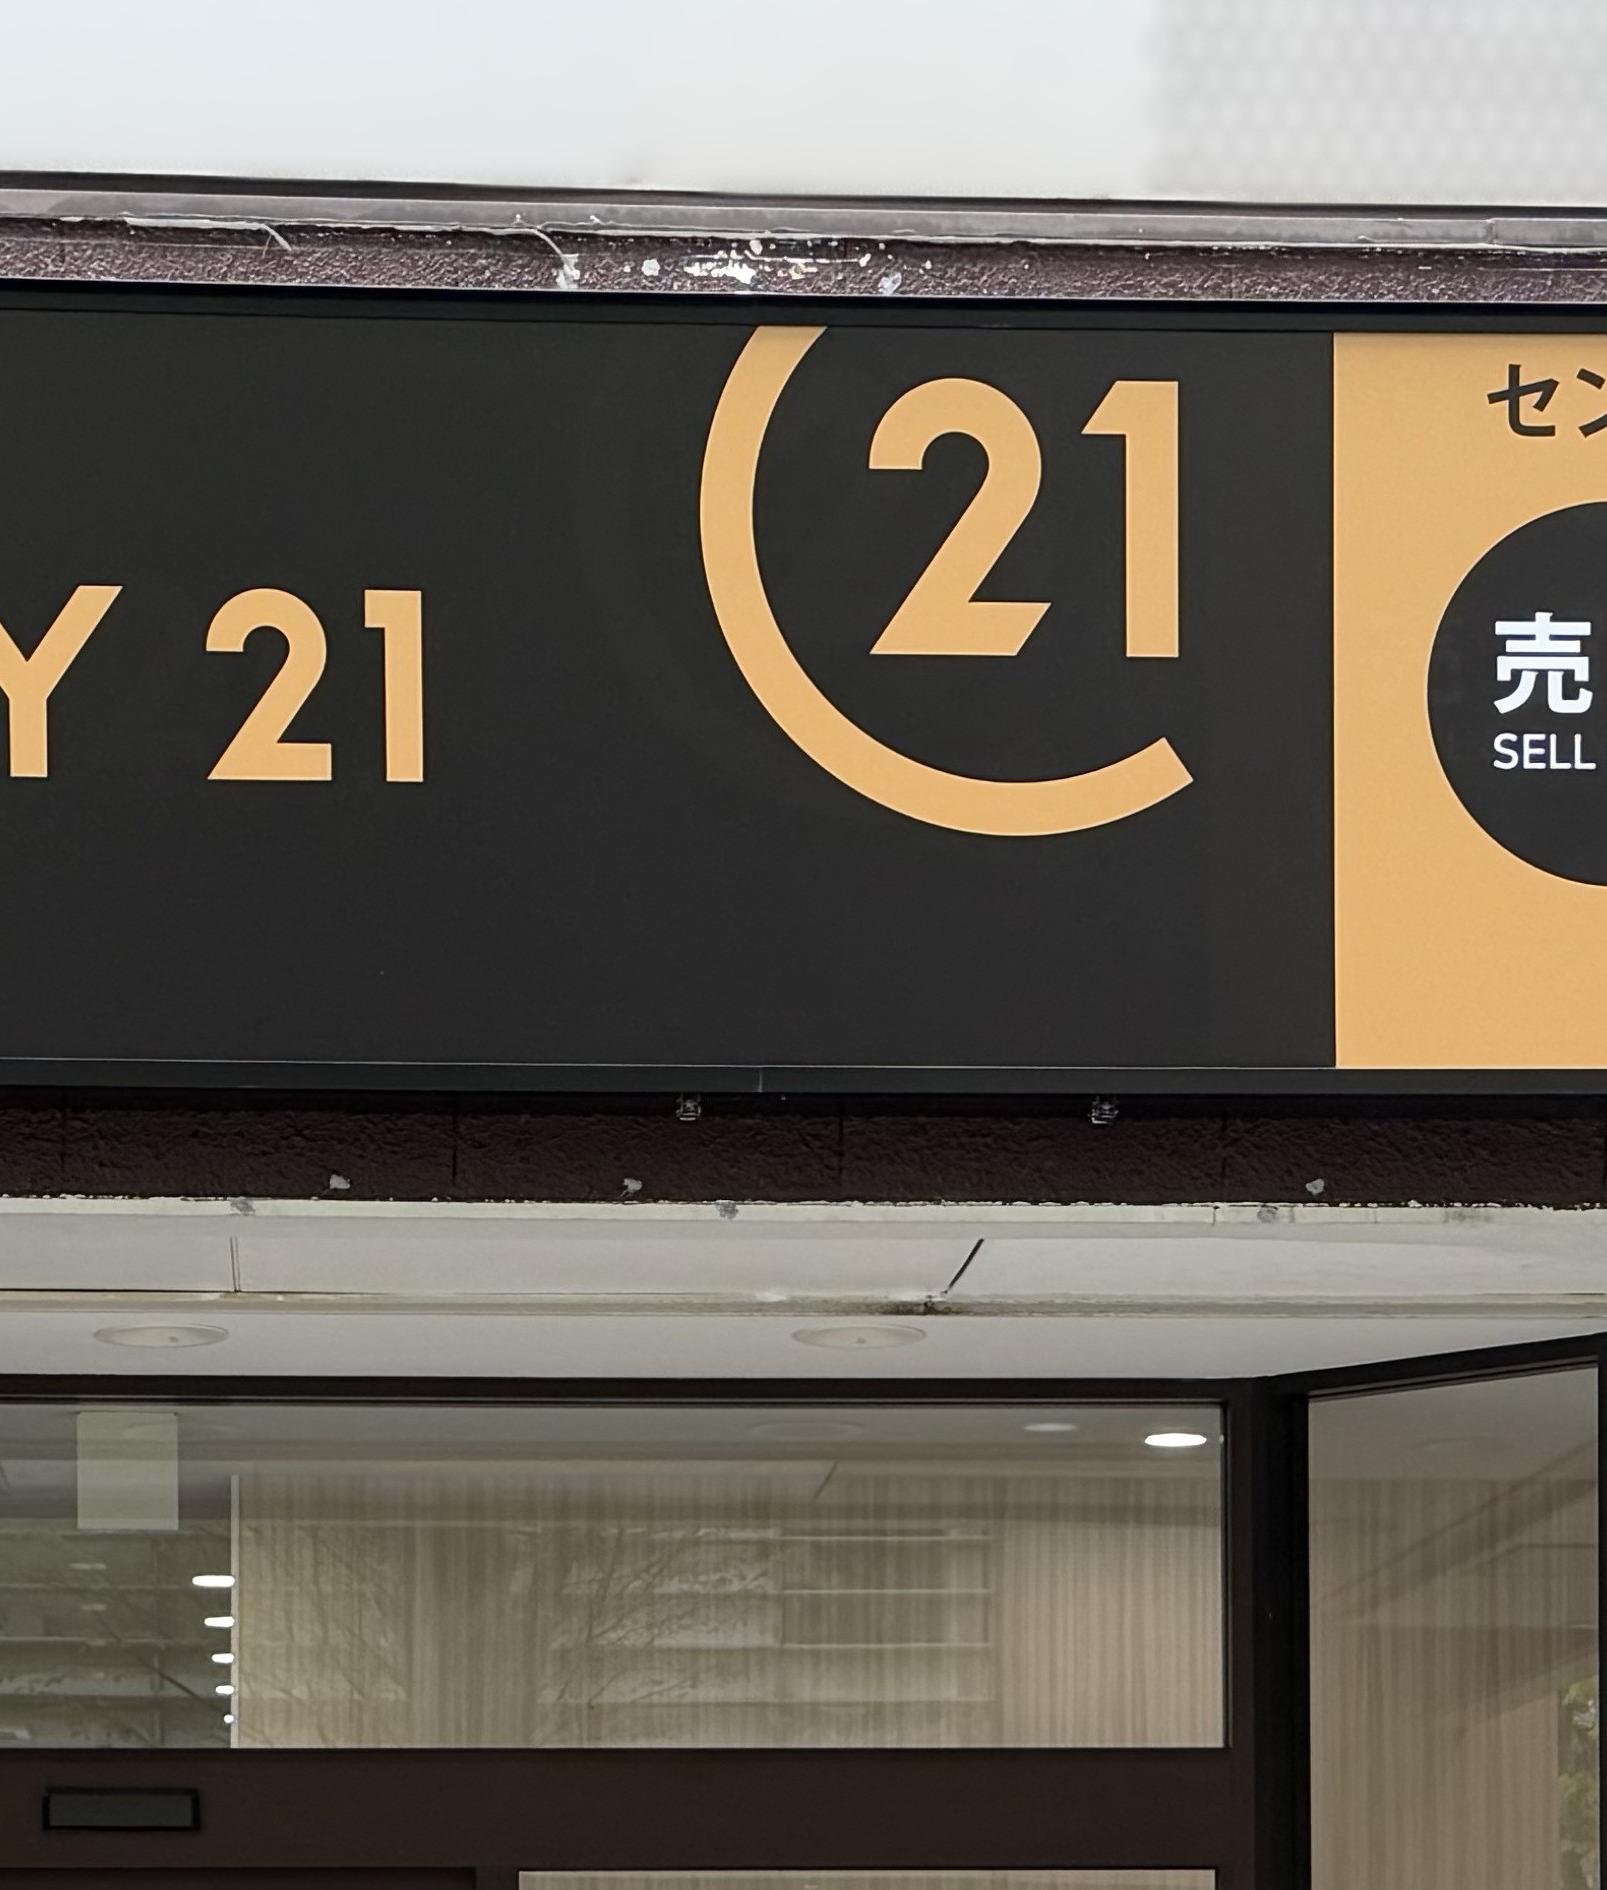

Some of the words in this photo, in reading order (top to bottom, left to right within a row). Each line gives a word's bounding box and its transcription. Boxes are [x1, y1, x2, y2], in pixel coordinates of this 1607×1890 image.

[869, 378, 1181, 659] 21
[206, 589, 425, 784] 21
[1494, 733, 1597, 771] SELL
